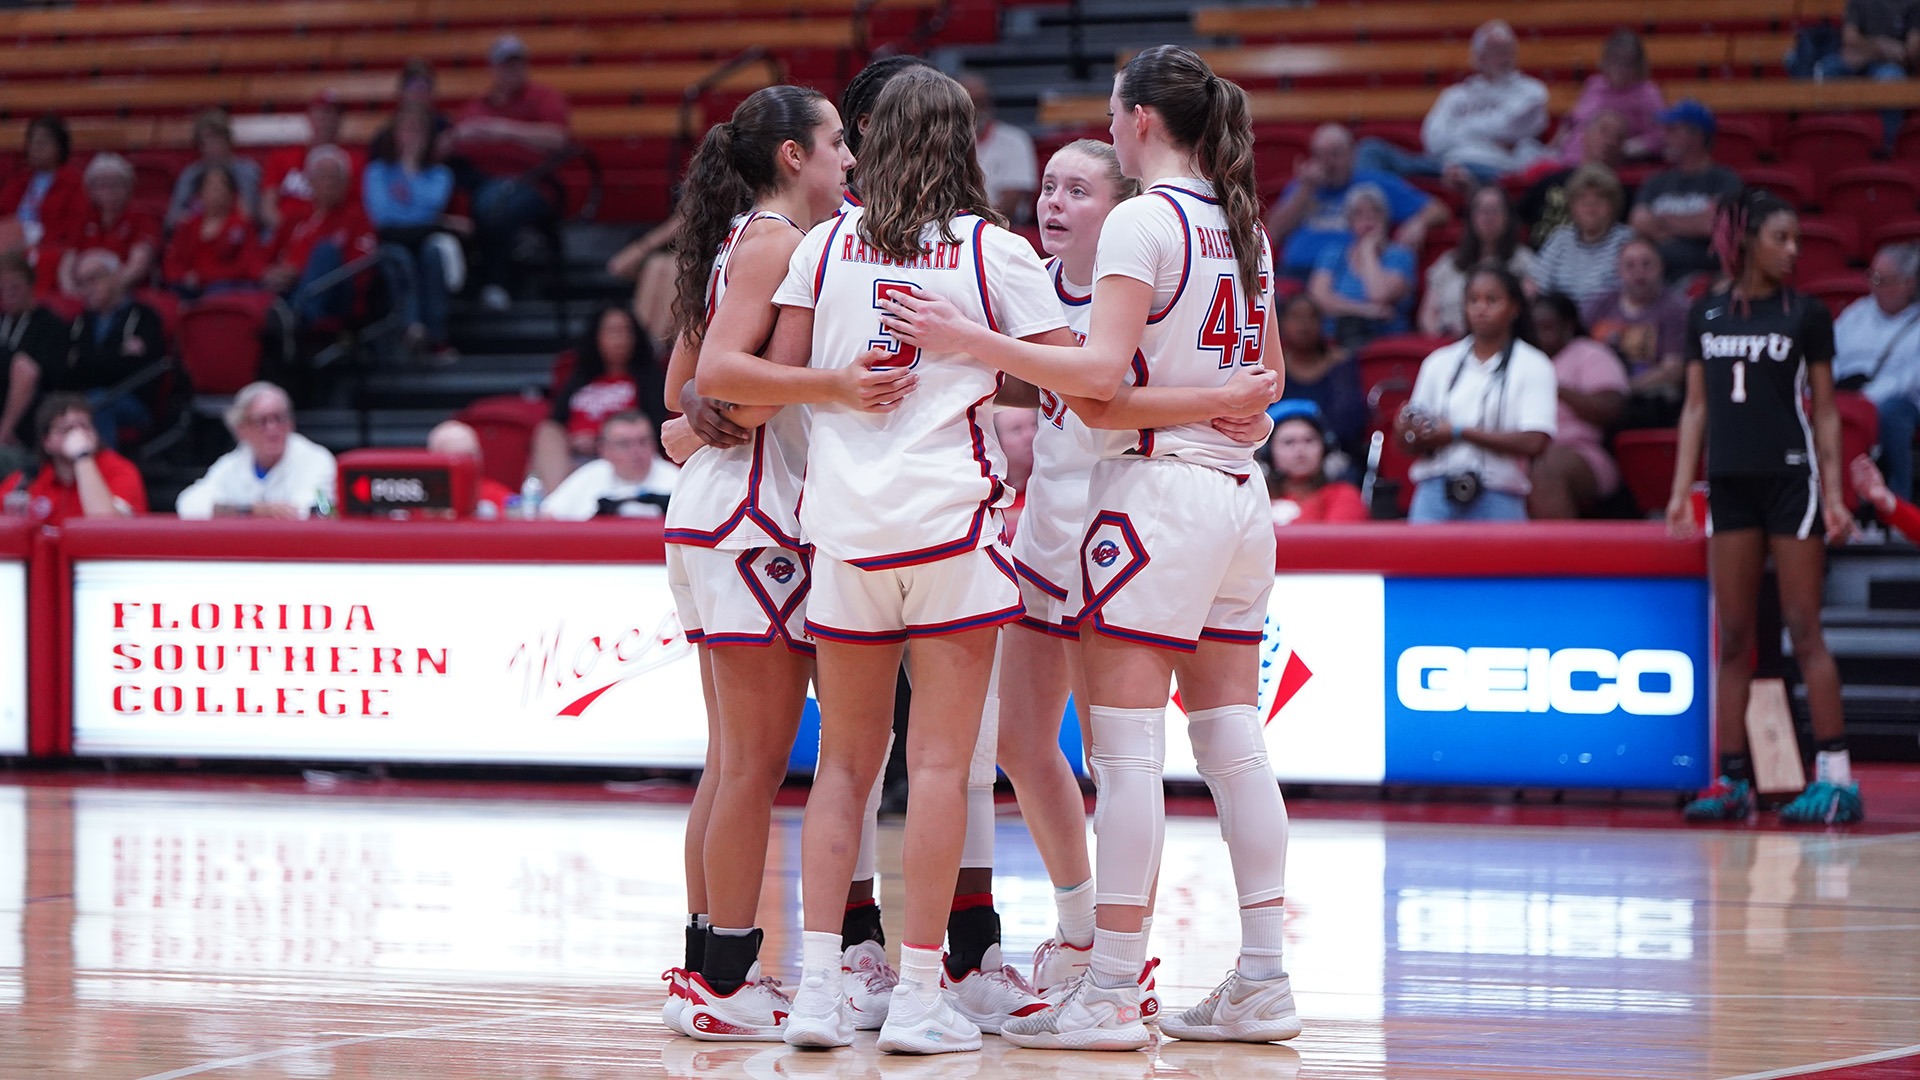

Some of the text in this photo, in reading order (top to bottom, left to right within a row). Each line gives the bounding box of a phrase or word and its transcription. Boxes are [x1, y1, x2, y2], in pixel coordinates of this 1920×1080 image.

[1197, 273, 1268, 369] 45
[1731, 360, 1747, 404] 1
[112, 602, 376, 632] FLORIDA
[112, 643, 449, 675] SOUTHERN
[1397, 645, 1694, 716] GEICO
[112, 684, 390, 717] COLLEGE
